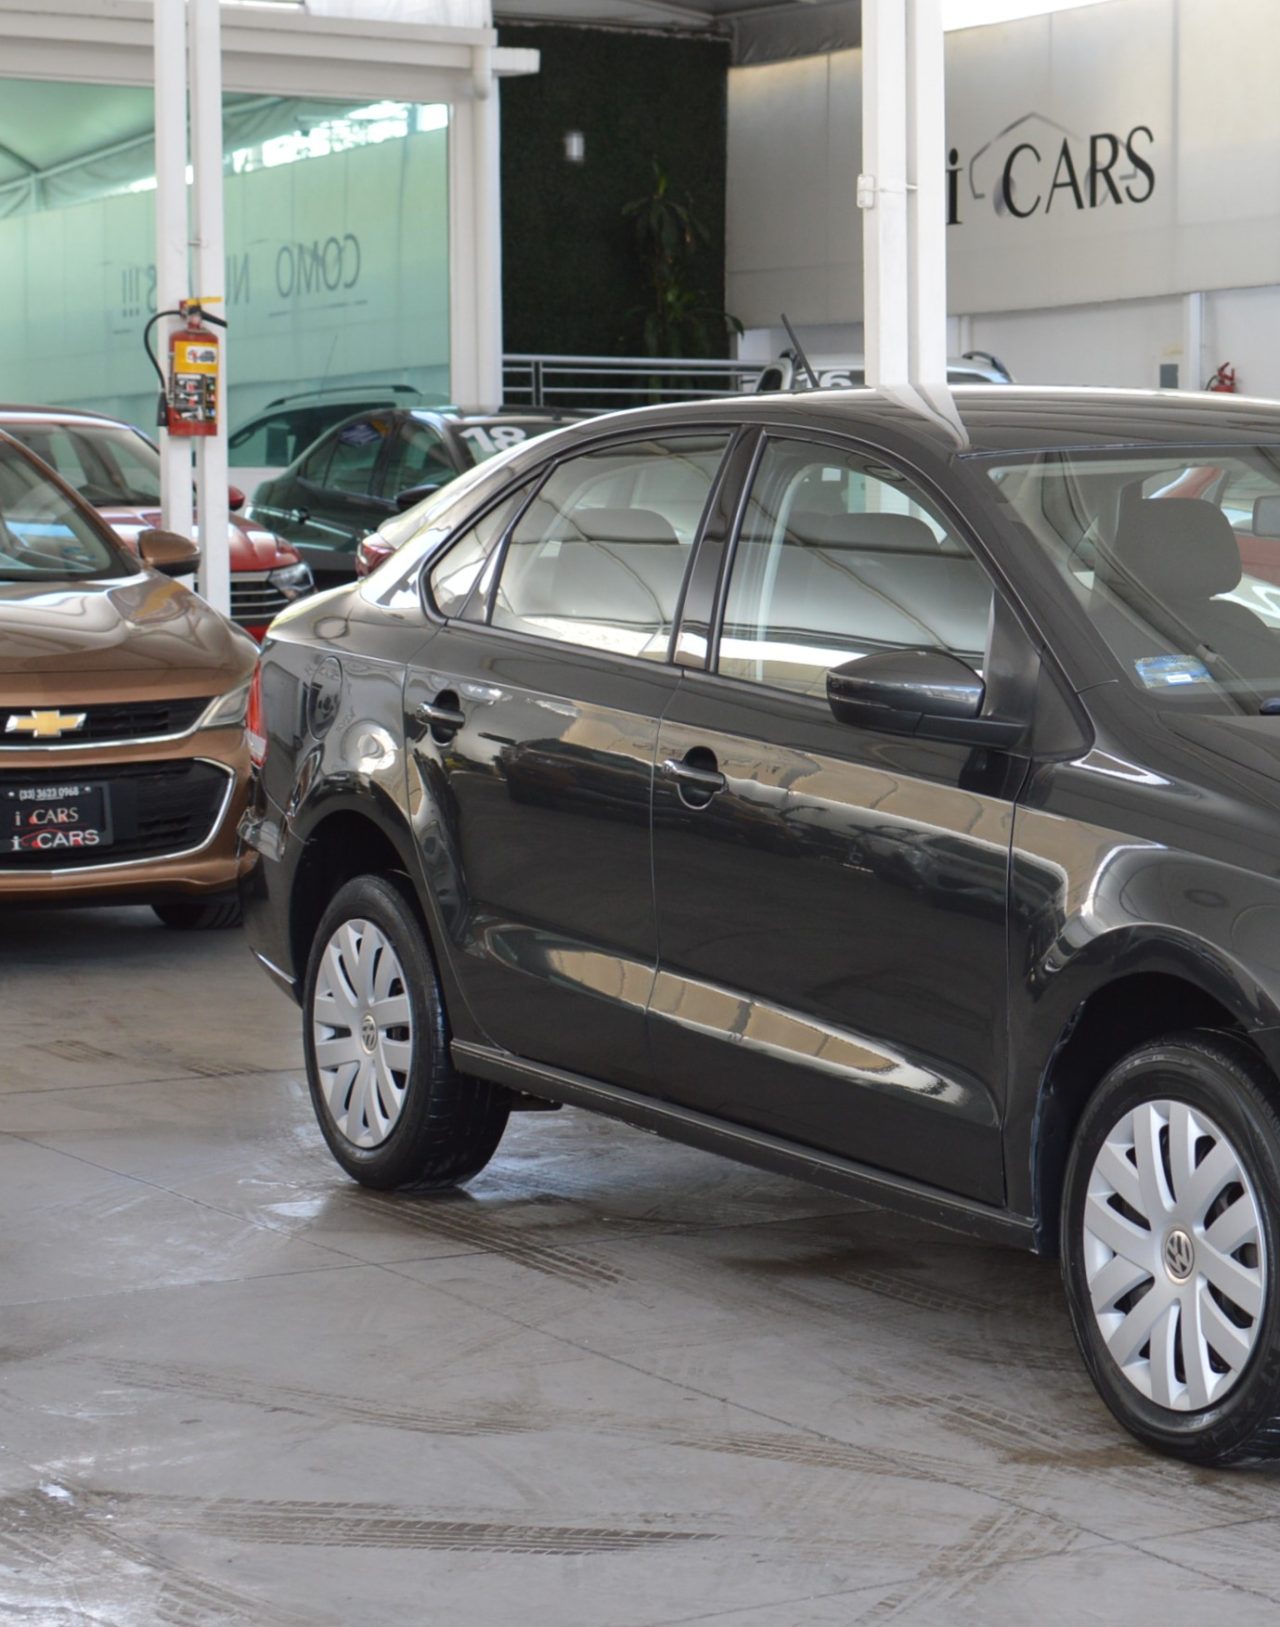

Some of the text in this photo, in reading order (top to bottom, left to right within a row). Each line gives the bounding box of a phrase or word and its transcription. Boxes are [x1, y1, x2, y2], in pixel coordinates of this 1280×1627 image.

[946, 126, 1155, 226] i CARS
[459, 426, 526, 452] 18
[15, 807, 79, 826] i CARS
[11, 829, 100, 851] i CARS
